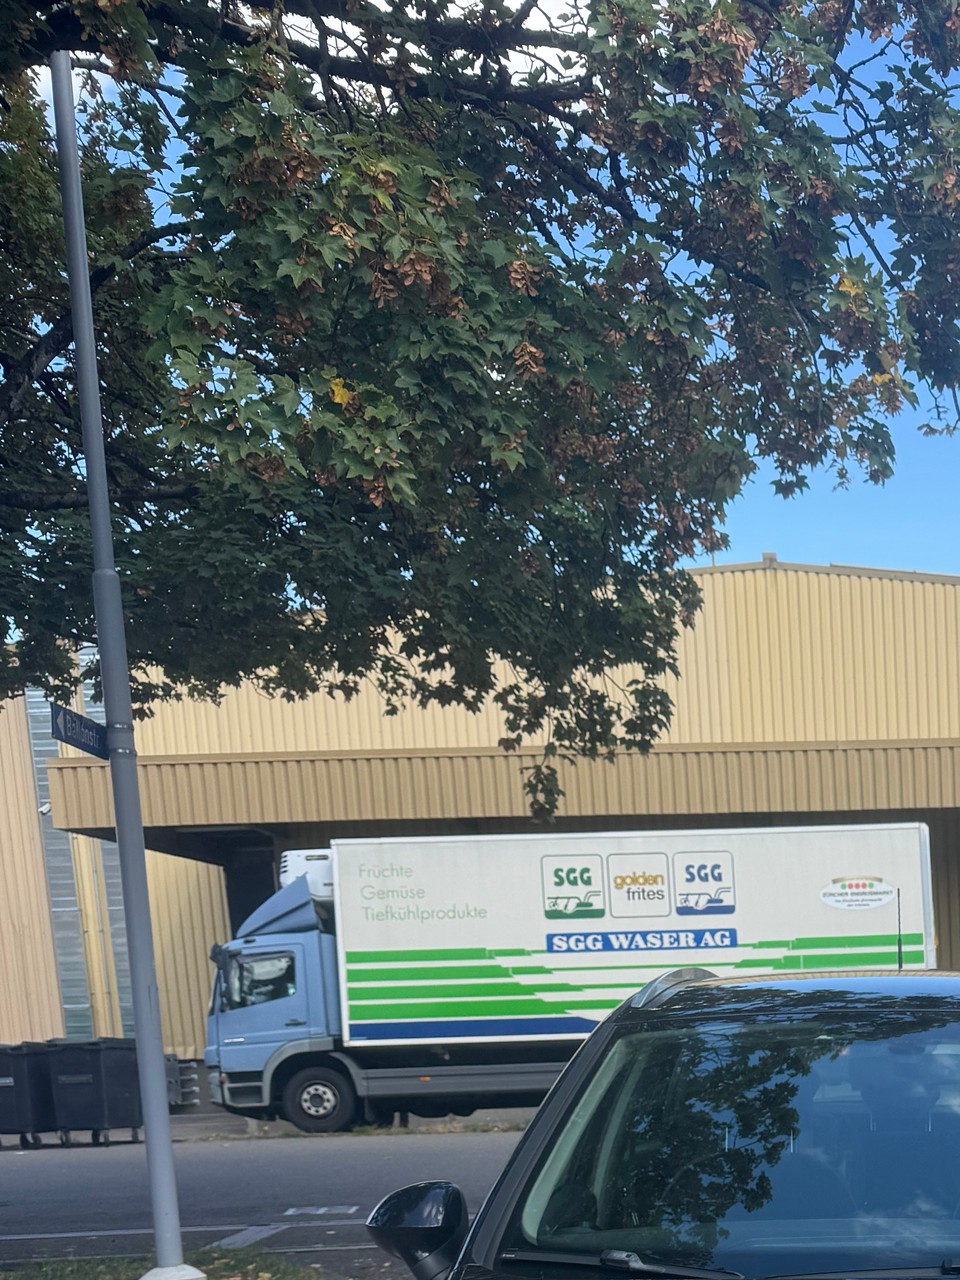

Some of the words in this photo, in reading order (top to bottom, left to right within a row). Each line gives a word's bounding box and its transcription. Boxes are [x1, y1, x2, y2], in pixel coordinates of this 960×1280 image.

[358, 863, 414, 878] Früchte
[553, 867, 592, 886] SGG
[685, 864, 723, 883] SGG
[613, 872, 665, 889] golden
[360, 885, 425, 900] Gemüse
[627, 887, 665, 901] frites
[362, 903, 488, 924] Tiefkühlprodukte
[553, 934, 603, 951] SGG
[608, 932, 696, 950] WASER
[701, 931, 731, 947] AG
